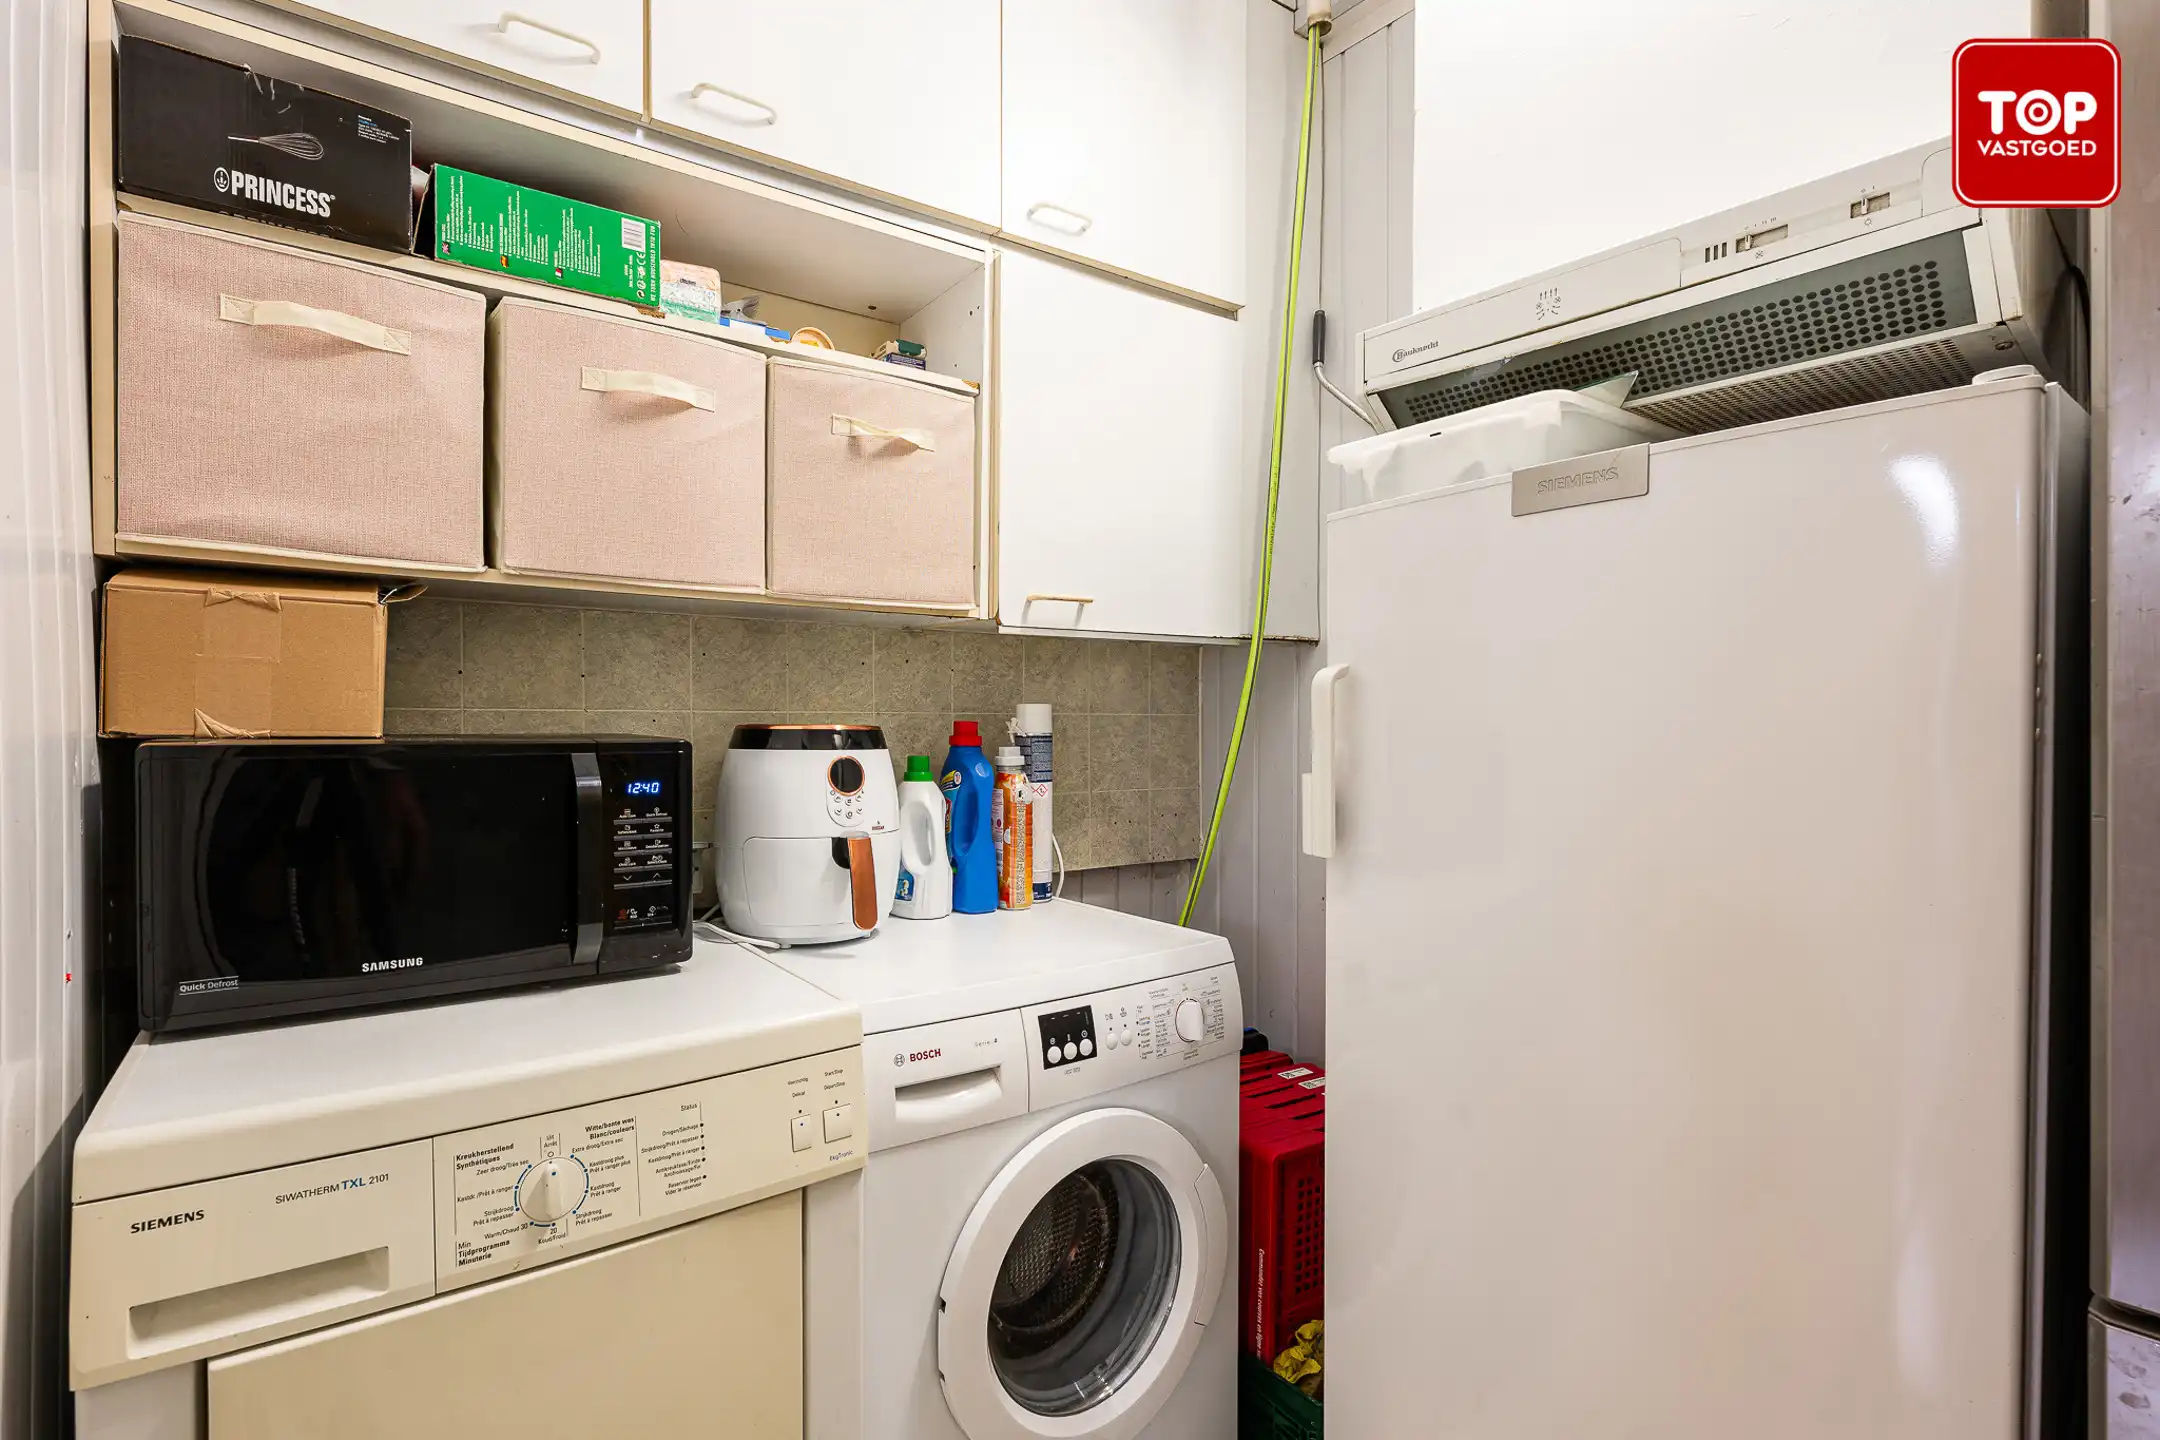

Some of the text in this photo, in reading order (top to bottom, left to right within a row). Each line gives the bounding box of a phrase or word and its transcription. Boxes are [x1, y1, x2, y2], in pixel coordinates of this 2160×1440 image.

[231, 170, 331, 218] PRINCESS
[1392, 340, 1439, 363] Bauknecht
[1536, 466, 1619, 494] SIEMENS
[626, 782, 660, 794] 12:40
[361, 957, 423, 973] SAMSUNG
[180, 978, 239, 993] Quick Defrost
[909, 1048, 942, 1063] BOSCH
[680, 1103, 698, 1111] Status
[622, 1117, 635, 1125] was
[589, 1125, 635, 1140] Blanc/couleurs
[456, 1143, 514, 1161] Kreukherstellend
[456, 1156, 500, 1170] Synthétiques
[589, 1155, 624, 1167] Kastdroog plus
[589, 1165, 600, 1173] Prêt
[275, 1173, 390, 1204] SIWATHERM TXL 2101
[590, 1181, 615, 1191] Kastdroog
[606, 1186, 621, 1194] ranger
[484, 1206, 514, 1217] Strijkdroog
[490, 1212, 514, 1222] repasser
[591, 1212, 613, 1222] repasser
[130, 1209, 205, 1234] SIEMENS
[484, 1222, 528, 1239] Warm/Chaud 30
[538, 1233, 566, 1244] Koud/Froid
[458, 1240, 510, 1258] Tijdprogramma
[458, 1253, 492, 1267] Minuterie
[1257, 1323, 1262, 1333] en
